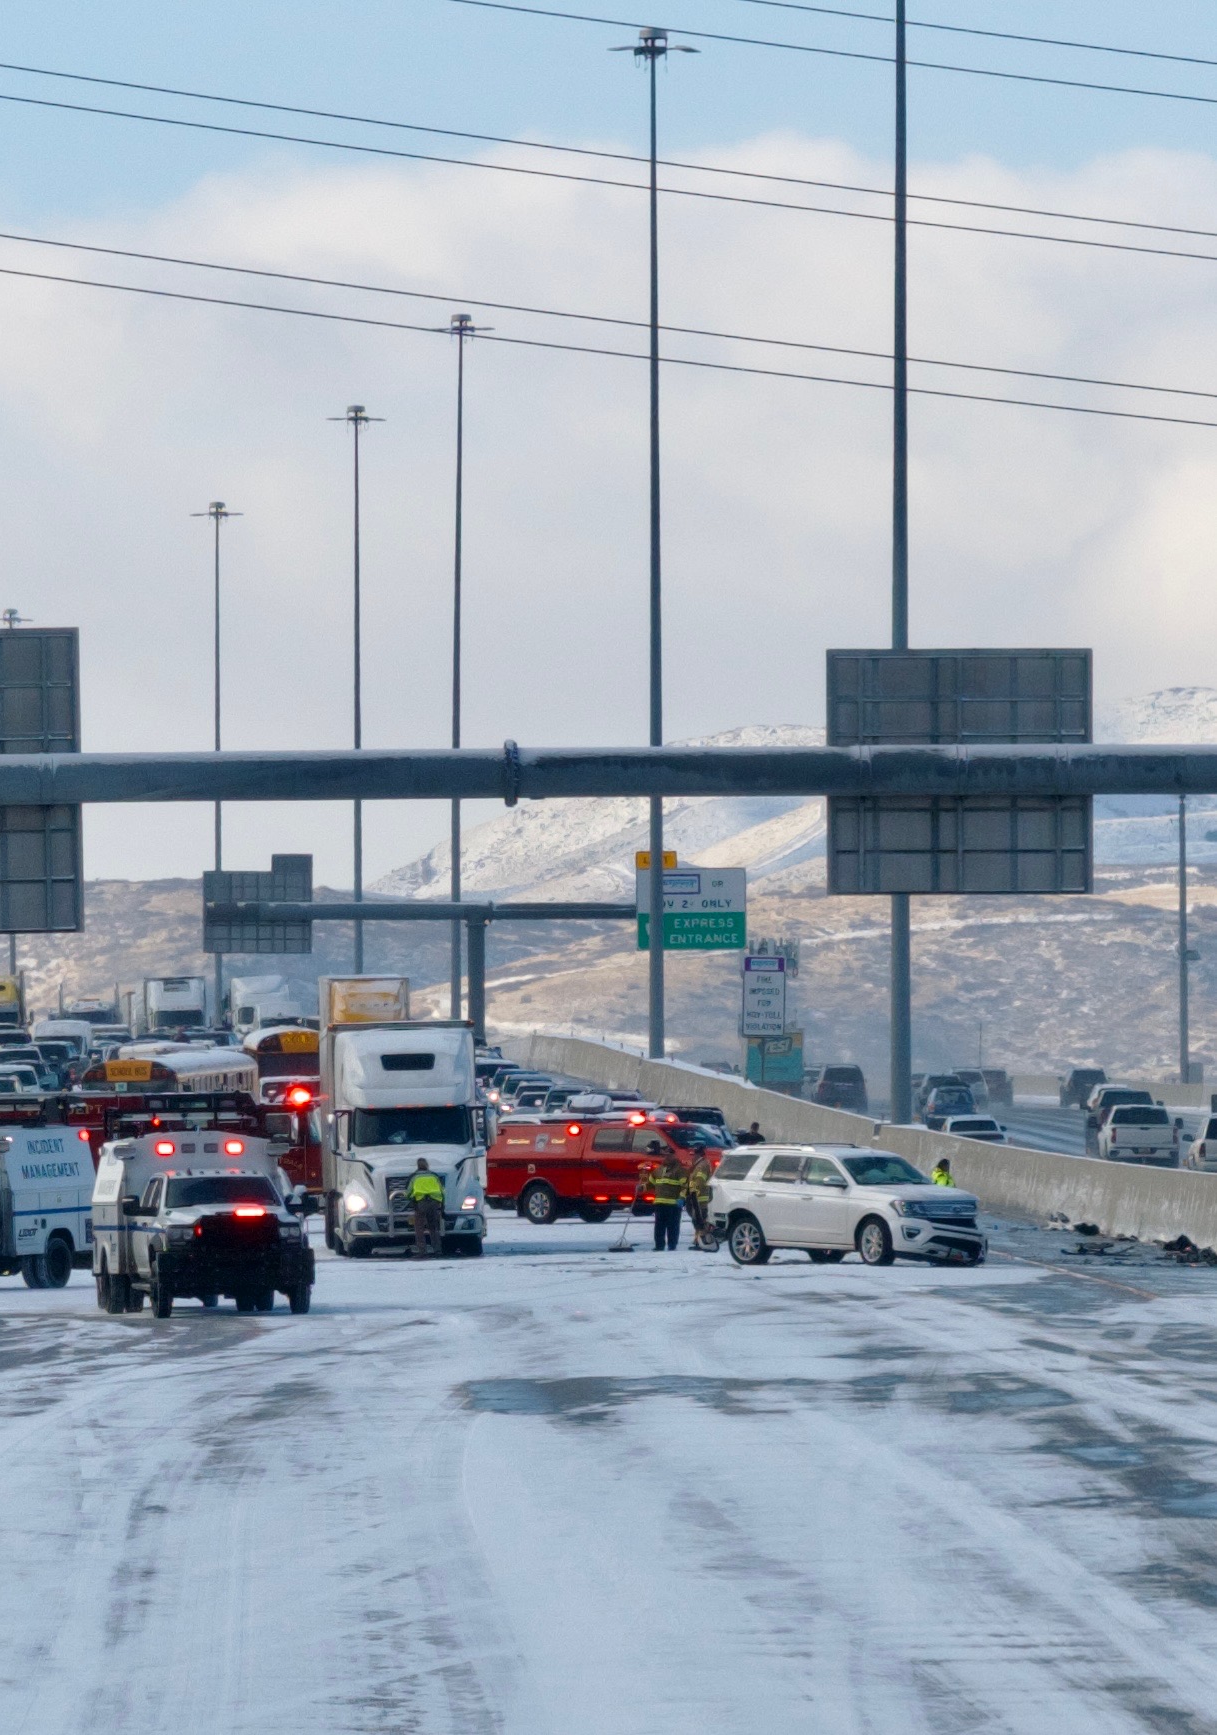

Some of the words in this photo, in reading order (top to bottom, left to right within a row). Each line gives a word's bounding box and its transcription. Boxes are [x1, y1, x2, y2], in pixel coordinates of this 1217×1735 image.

[701, 900, 732, 908] ONLY
[674, 918, 734, 929] EXPRESS
[669, 933, 738, 944] ENTRANCE
[27, 1138, 65, 1155] INCIDENT
[21, 1162, 80, 1179] MANAGEMENT
